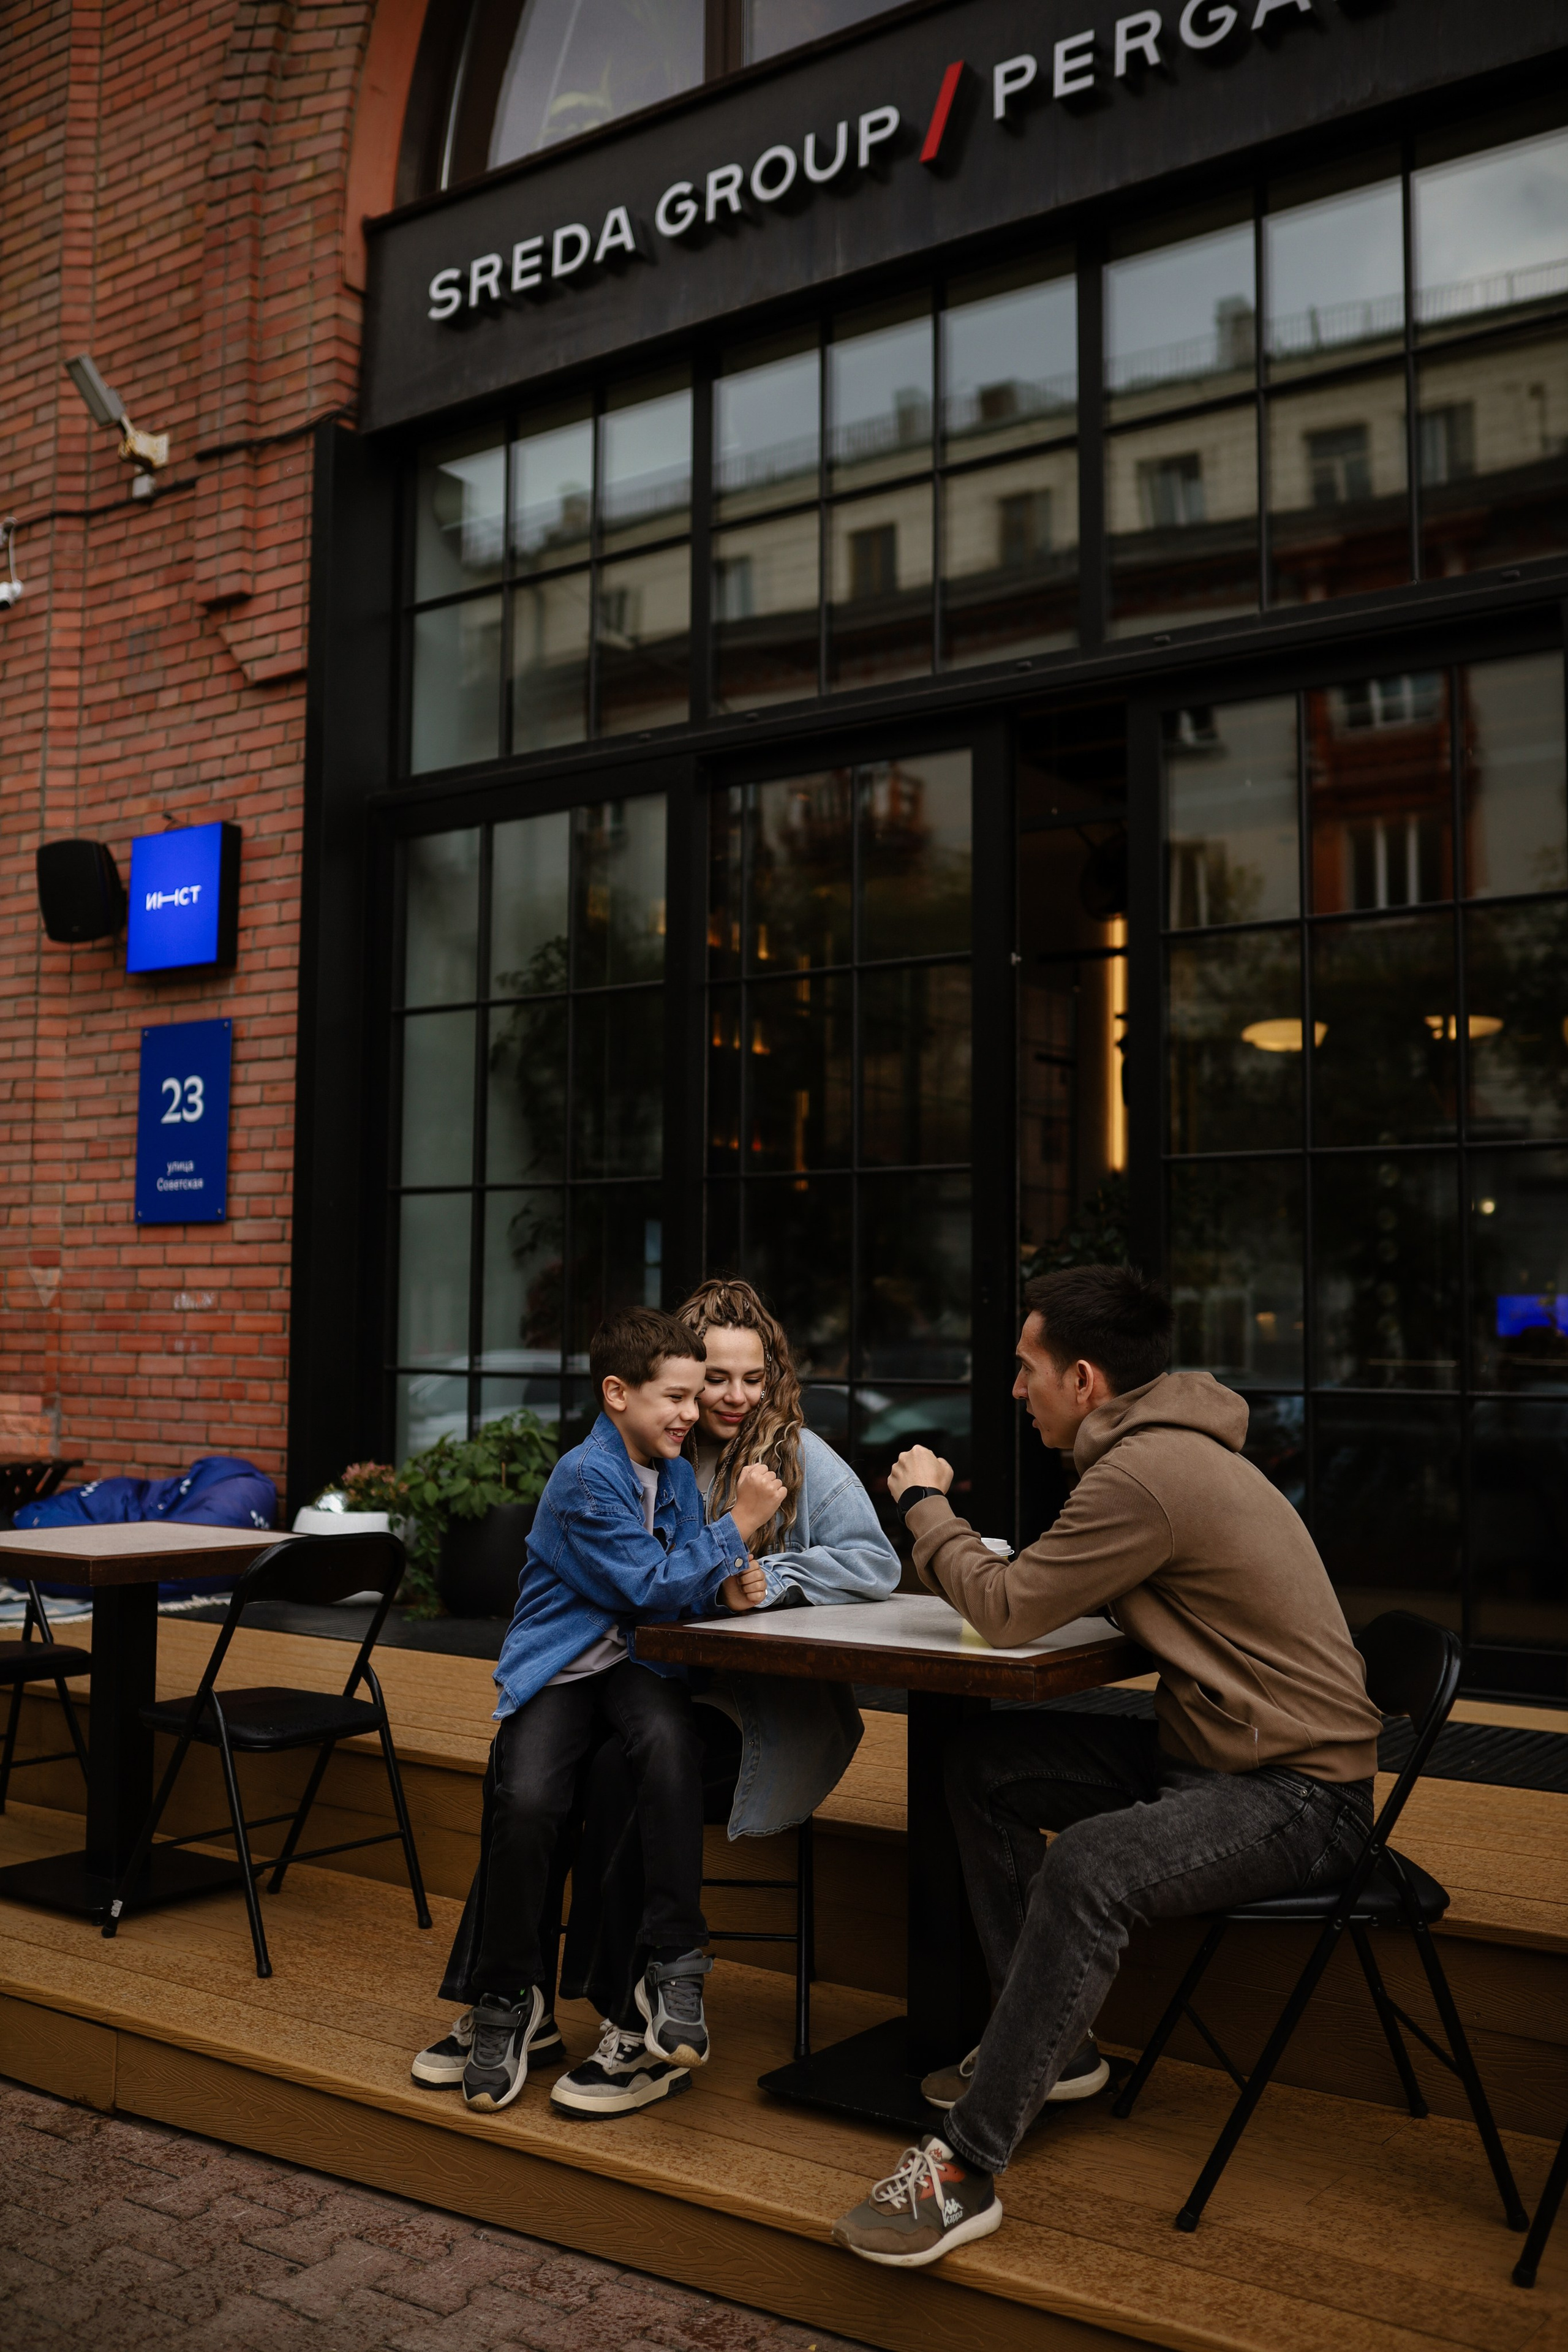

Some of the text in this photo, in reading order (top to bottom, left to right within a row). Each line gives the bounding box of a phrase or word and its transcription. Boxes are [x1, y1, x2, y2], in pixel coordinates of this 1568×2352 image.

[429, 206, 635, 319] SREDA
[655, 106, 900, 236] GROUP
[161, 1076, 204, 1124] 23
[156, 1177, 204, 1191] Советская
[167, 1160, 194, 1176] улица
